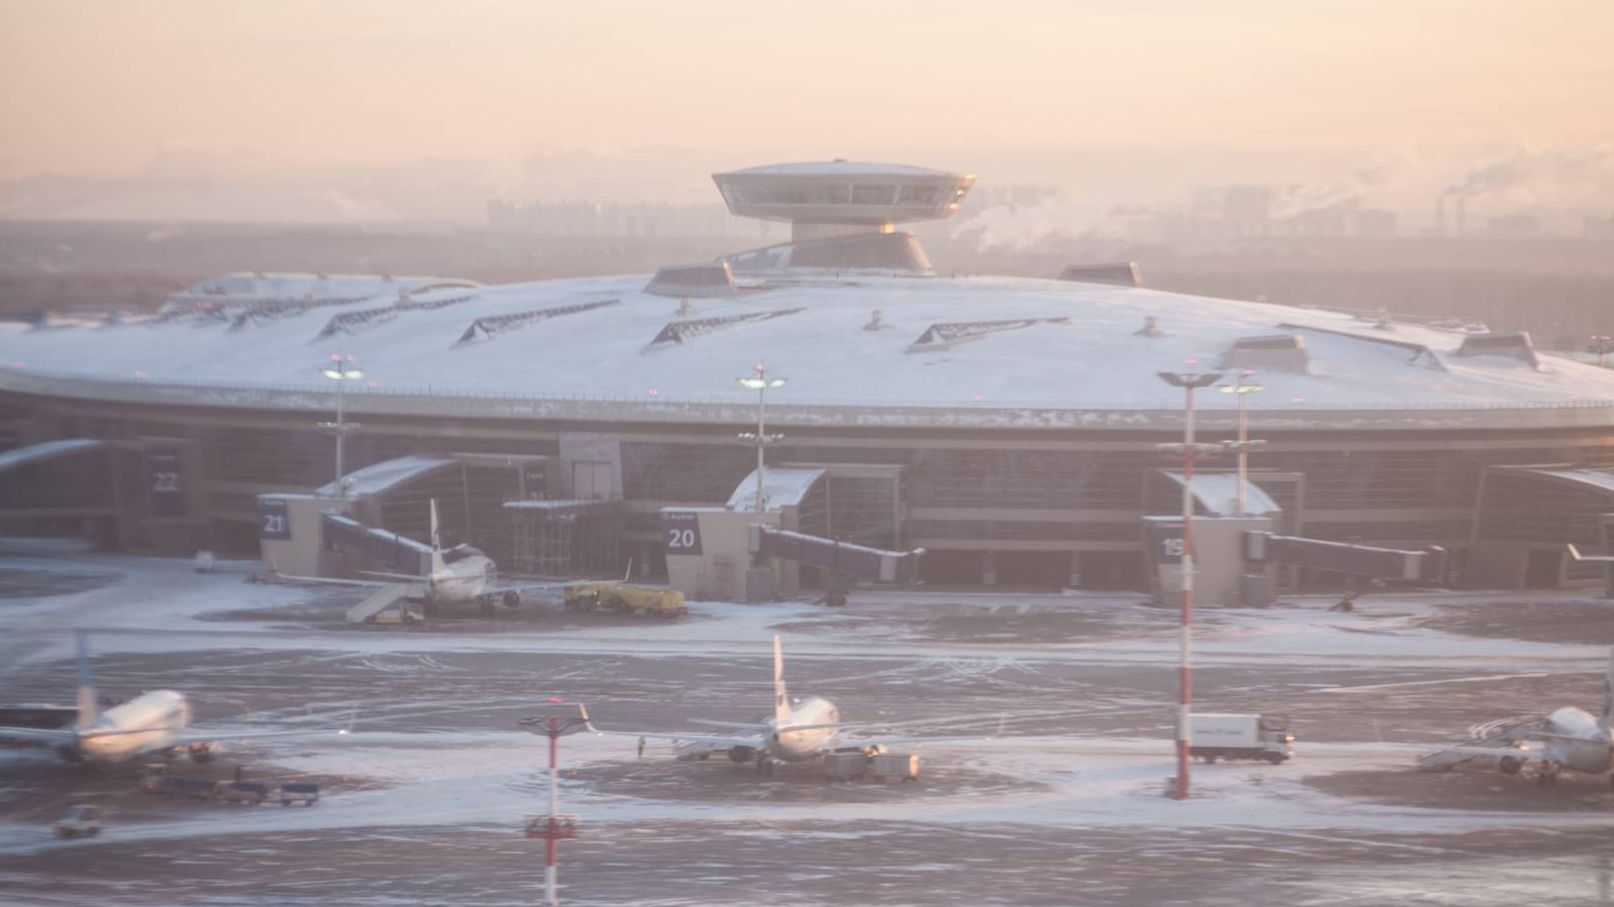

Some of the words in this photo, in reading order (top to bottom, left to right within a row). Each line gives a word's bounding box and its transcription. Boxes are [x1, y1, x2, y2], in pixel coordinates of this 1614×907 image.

[153, 472, 178, 491] 22
[264, 514, 283, 532] 21
[669, 529, 694, 547] 20
